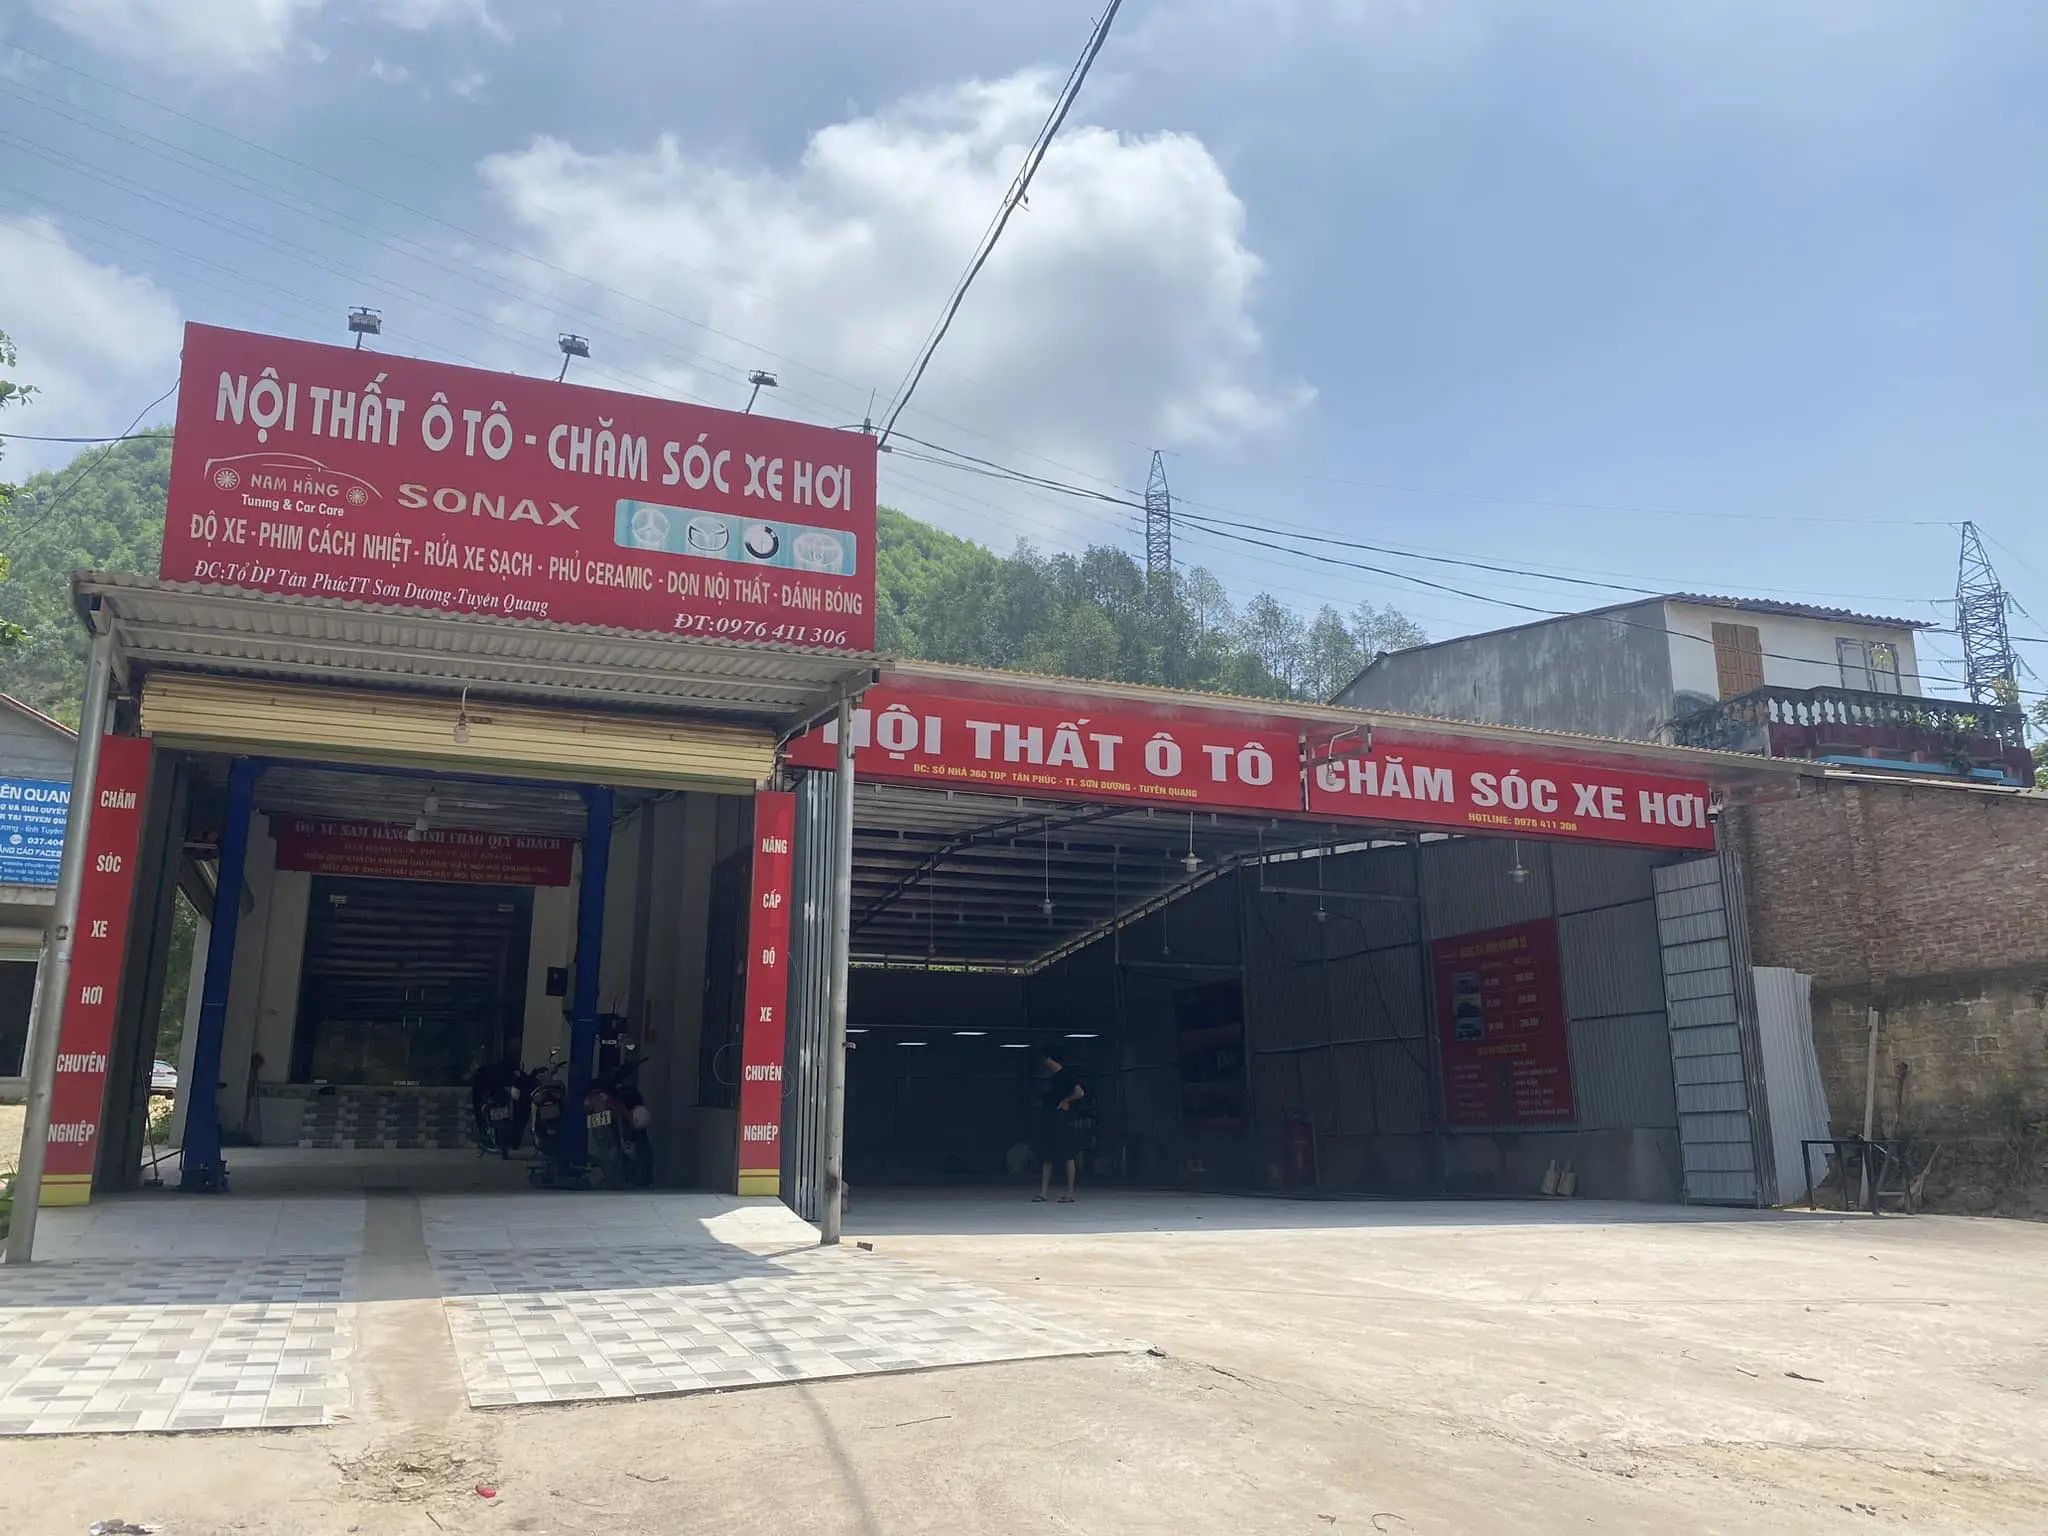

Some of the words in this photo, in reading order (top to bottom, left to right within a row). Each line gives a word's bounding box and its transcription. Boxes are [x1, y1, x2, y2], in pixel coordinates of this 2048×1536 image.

[215, 366, 298, 444] NỘI
[309, 372, 406, 447] THẤT
[421, 391, 454, 453] Ô
[462, 400, 514, 462] TÔ
[548, 416, 649, 482] CHĂM
[662, 433, 731, 494] SÓC
[743, 453, 784, 502] XE
[793, 460, 852, 511] HƠI
[250, 474, 287, 492] NAM
[241, 494, 280, 511] Tuning
[282, 499, 293, 511] &
[296, 500, 316, 514] Car
[318, 503, 345, 517] Care
[397, 483, 581, 531] SONAX
[190, 509, 218, 548] ĐỘ
[222, 517, 247, 545] XE
[259, 521, 304, 551] PHIM
[308, 523, 356, 557] CÁCH
[362, 531, 413, 569] NHIỆT
[424, 532, 459, 569] RỬA
[463, 545, 486, 572] XE
[488, 548, 533, 581] SẠCH
[549, 549, 581, 583] PHỦ
[585, 560, 653, 591] CERAMIC
[667, 570, 700, 601] DỌN
[704, 571, 730, 606] NỘI
[734, 572, 771, 605] THẤT
[781, 581, 822, 611] ĐÁNH
[825, 585, 863, 615] BÓNG
[372, 578, 401, 597] Sơn
[405, 582, 451, 607] Dương
[503, 593, 549, 617] Quang
[771, 623, 807, 641] 411
[810, 627, 848, 645] 306
[965, 718, 1123, 771] THẤT
[1145, 732, 1183, 777] Ô
[1202, 742, 1273, 786] TÔ
[932, 763, 945, 775] SỐ
[947, 766, 967, 777] NHÀ
[1032, 773, 1057, 785] PHÚC
[1168, 787, 1198, 798] QUANG
[100, 789, 137, 811] CHĂM
[1315, 755, 1455, 804] CHĂM
[1470, 768, 1560, 814] SÓC
[1572, 783, 1626, 822] XE
[1638, 790, 1706, 829] HƠI
[1468, 813, 1512, 825] HOTLINE:
[761, 836, 788, 855] NÂNG
[96, 850, 122, 874] SÓC
[762, 888, 782, 910] CẤP
[90, 920, 109, 939] XE
[762, 948, 776, 970] ĐỘ
[81, 985, 104, 1006] HƠI
[759, 1006, 773, 1023] XE
[56, 1049, 107, 1074] CHUYÊN
[744, 1063, 783, 1082] CHUYÊN
[47, 1122, 95, 1148] NGHIỆP
[743, 1123, 779, 1144] NGHIỆP
